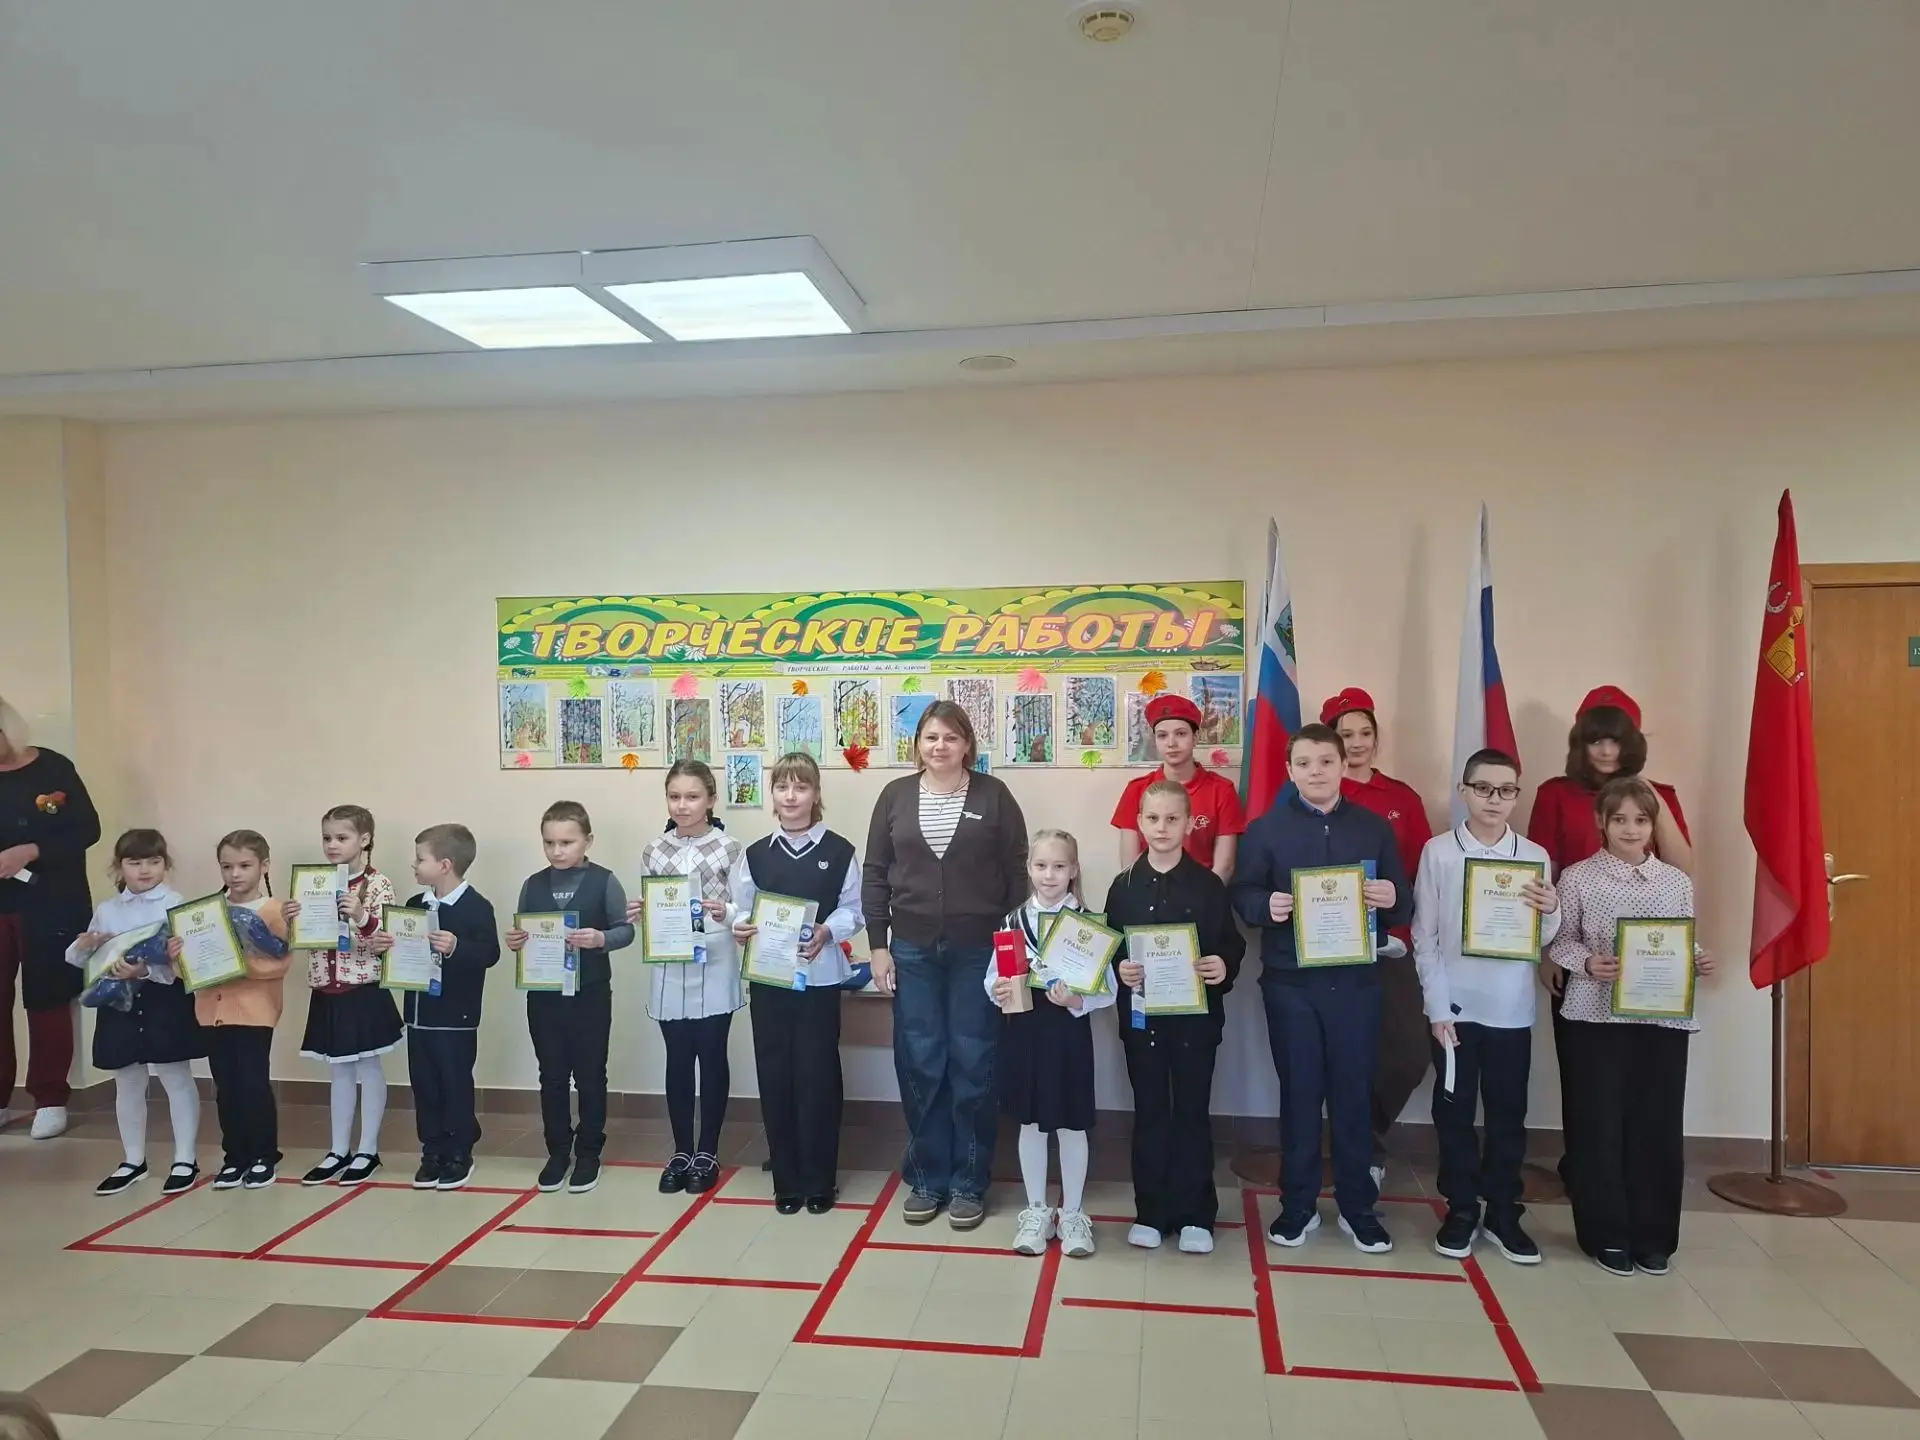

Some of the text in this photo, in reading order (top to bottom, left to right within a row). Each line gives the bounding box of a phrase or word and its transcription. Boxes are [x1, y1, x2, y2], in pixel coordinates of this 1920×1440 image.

[533, 610, 1218, 659] ТВОРЧЕСКИЕ РАБОТЫ
[787, 665, 831, 673] ТВОРЧЕСКИЕ
[1311, 895, 1349, 903] ГРАМОТА
[1063, 938, 1096, 957] ГРАМОТА
[1146, 949, 1182, 958] ГРАМОТА
[1636, 949, 1676, 957] ГРАМОТА
